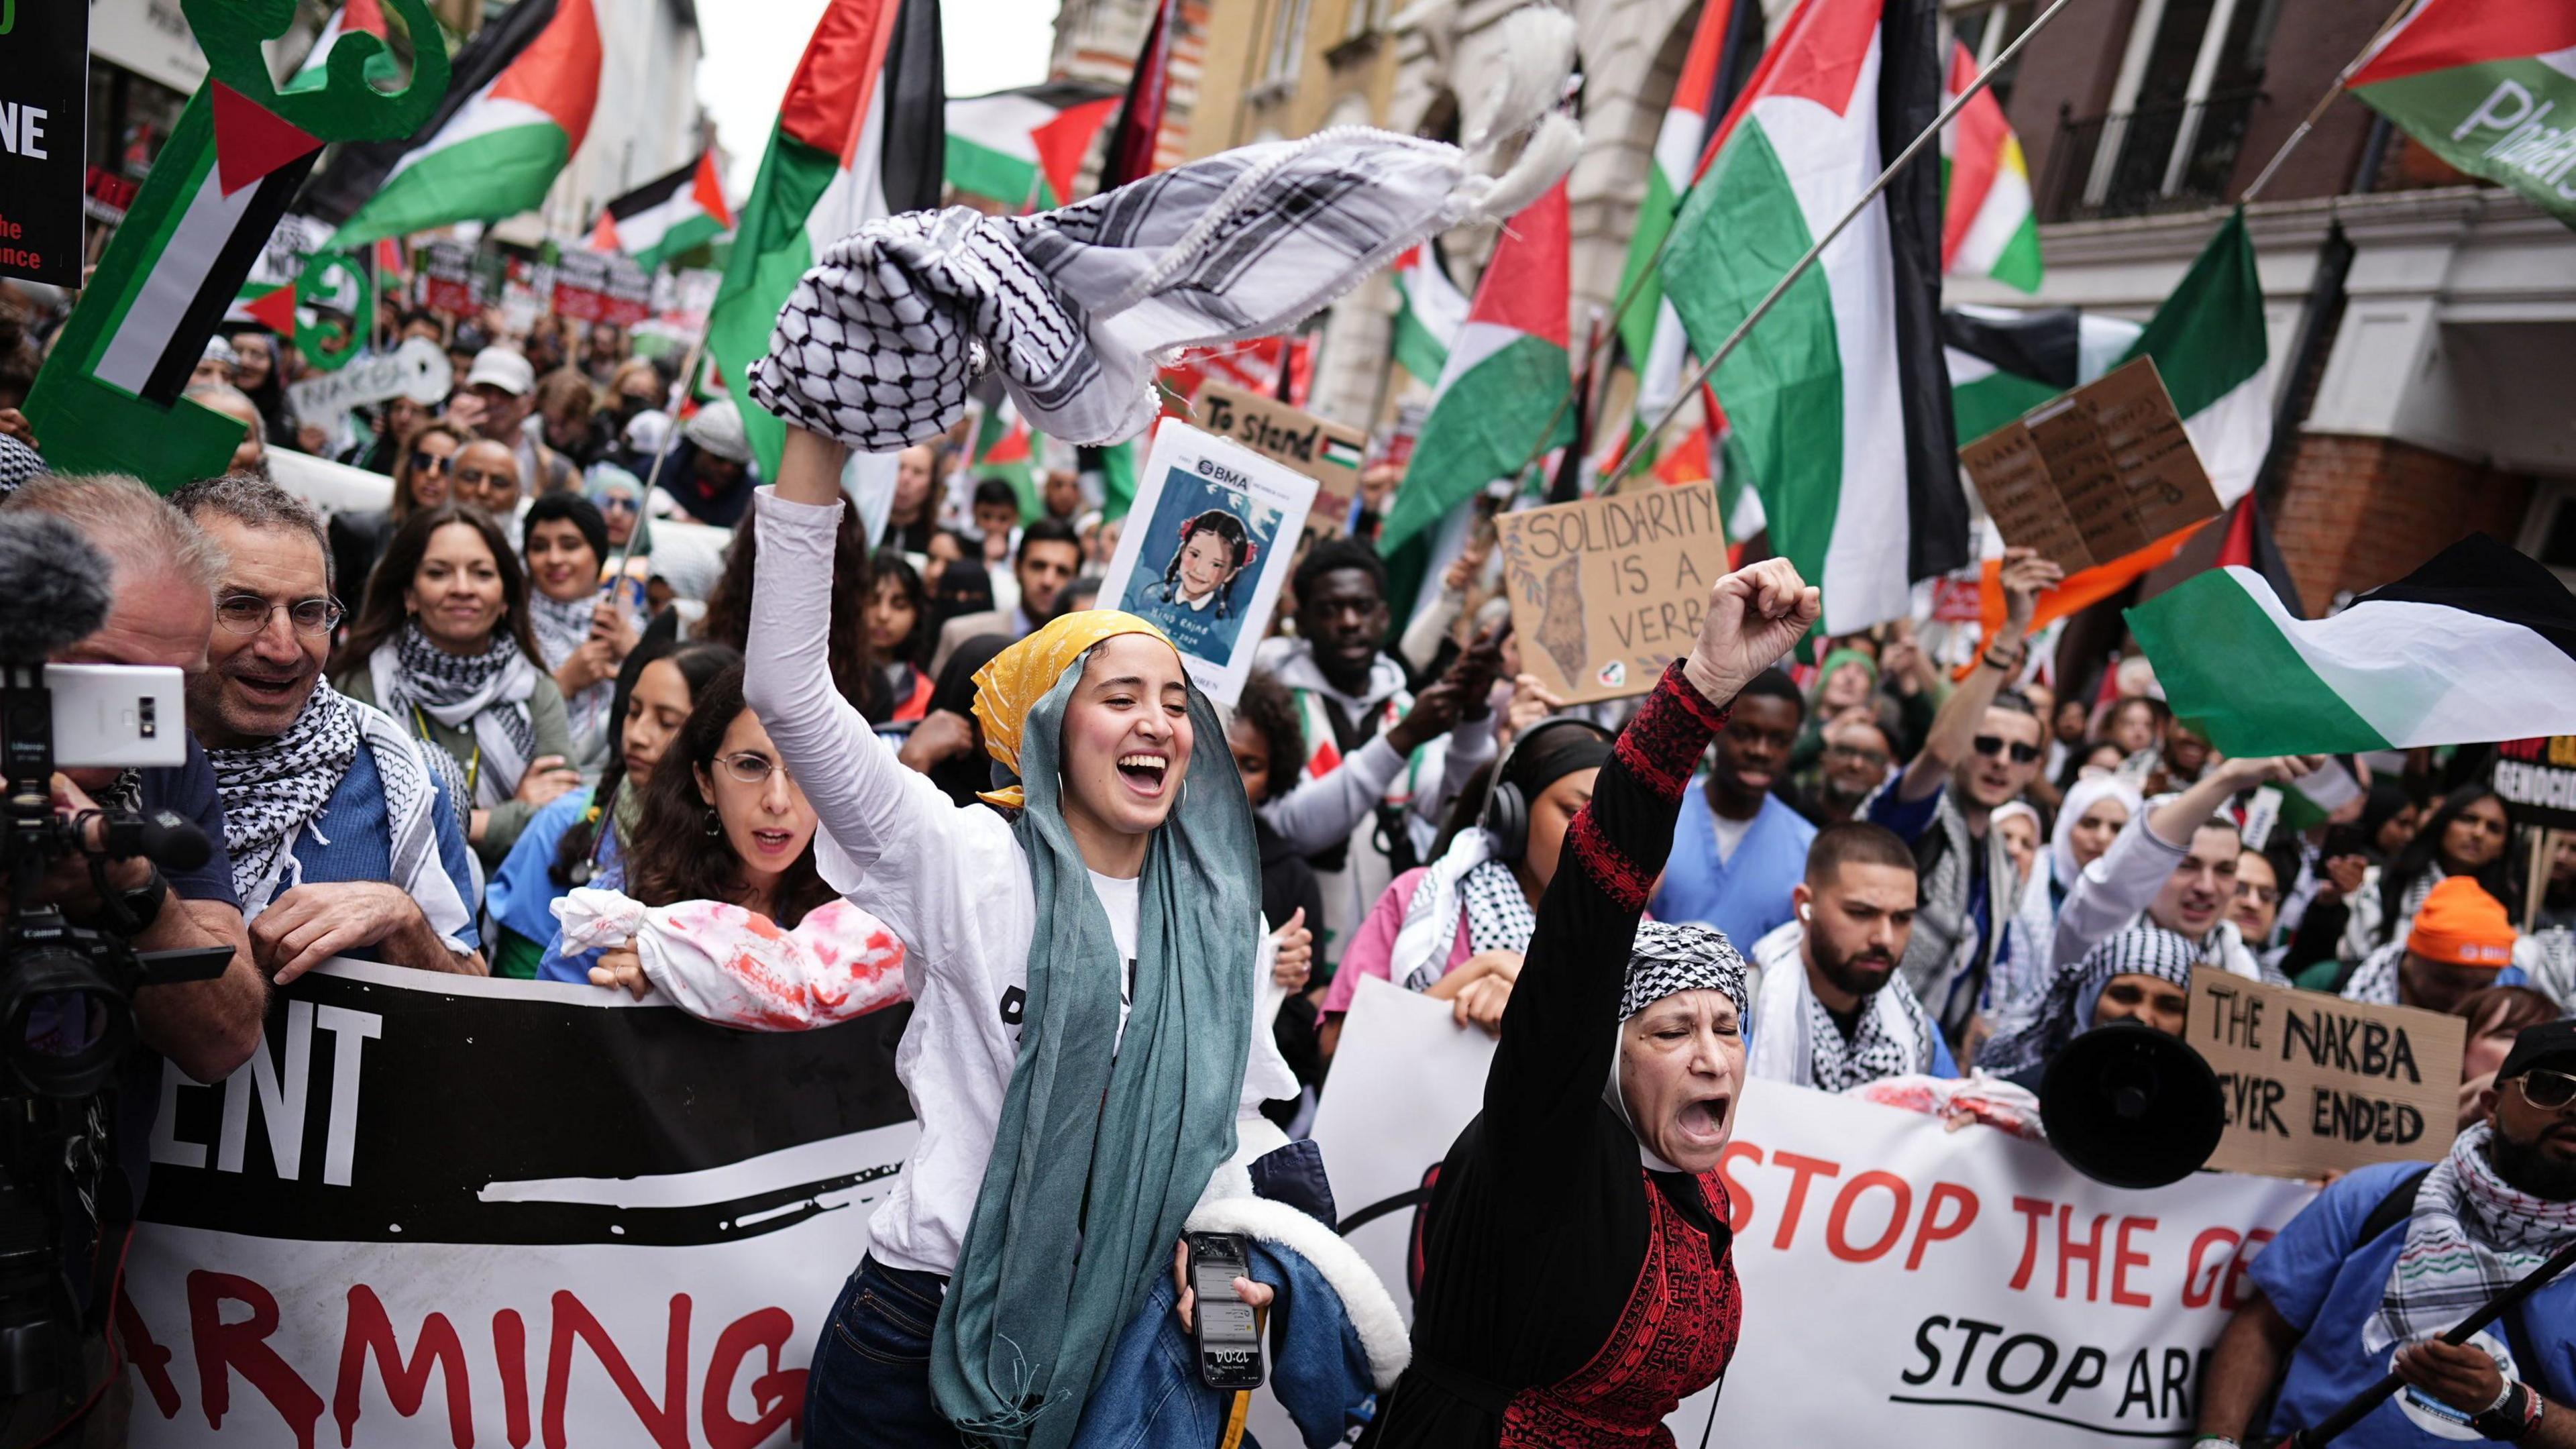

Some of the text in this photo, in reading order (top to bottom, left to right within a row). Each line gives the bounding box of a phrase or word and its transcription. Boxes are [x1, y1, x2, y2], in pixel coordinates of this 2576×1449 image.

[0, 248, 42, 269] nce
[1205, 395, 1320, 463] To Stand
[1213, 466, 1248, 491] BMA
[1527, 486, 1714, 558] SOLIDARITY
[1611, 550, 1702, 595] IS A
[1609, 598, 1705, 649] VERB
[2208, 982, 2422, 1085] THE NAKBA
[2218, 1071, 2424, 1146] EVER ENDED
[1719, 1140, 1980, 1272] STOP
[2008, 1196, 2158, 1309] THE
[1215, 1348, 1249, 1363] 12:04
[1901, 1316, 2107, 1405] STOP
